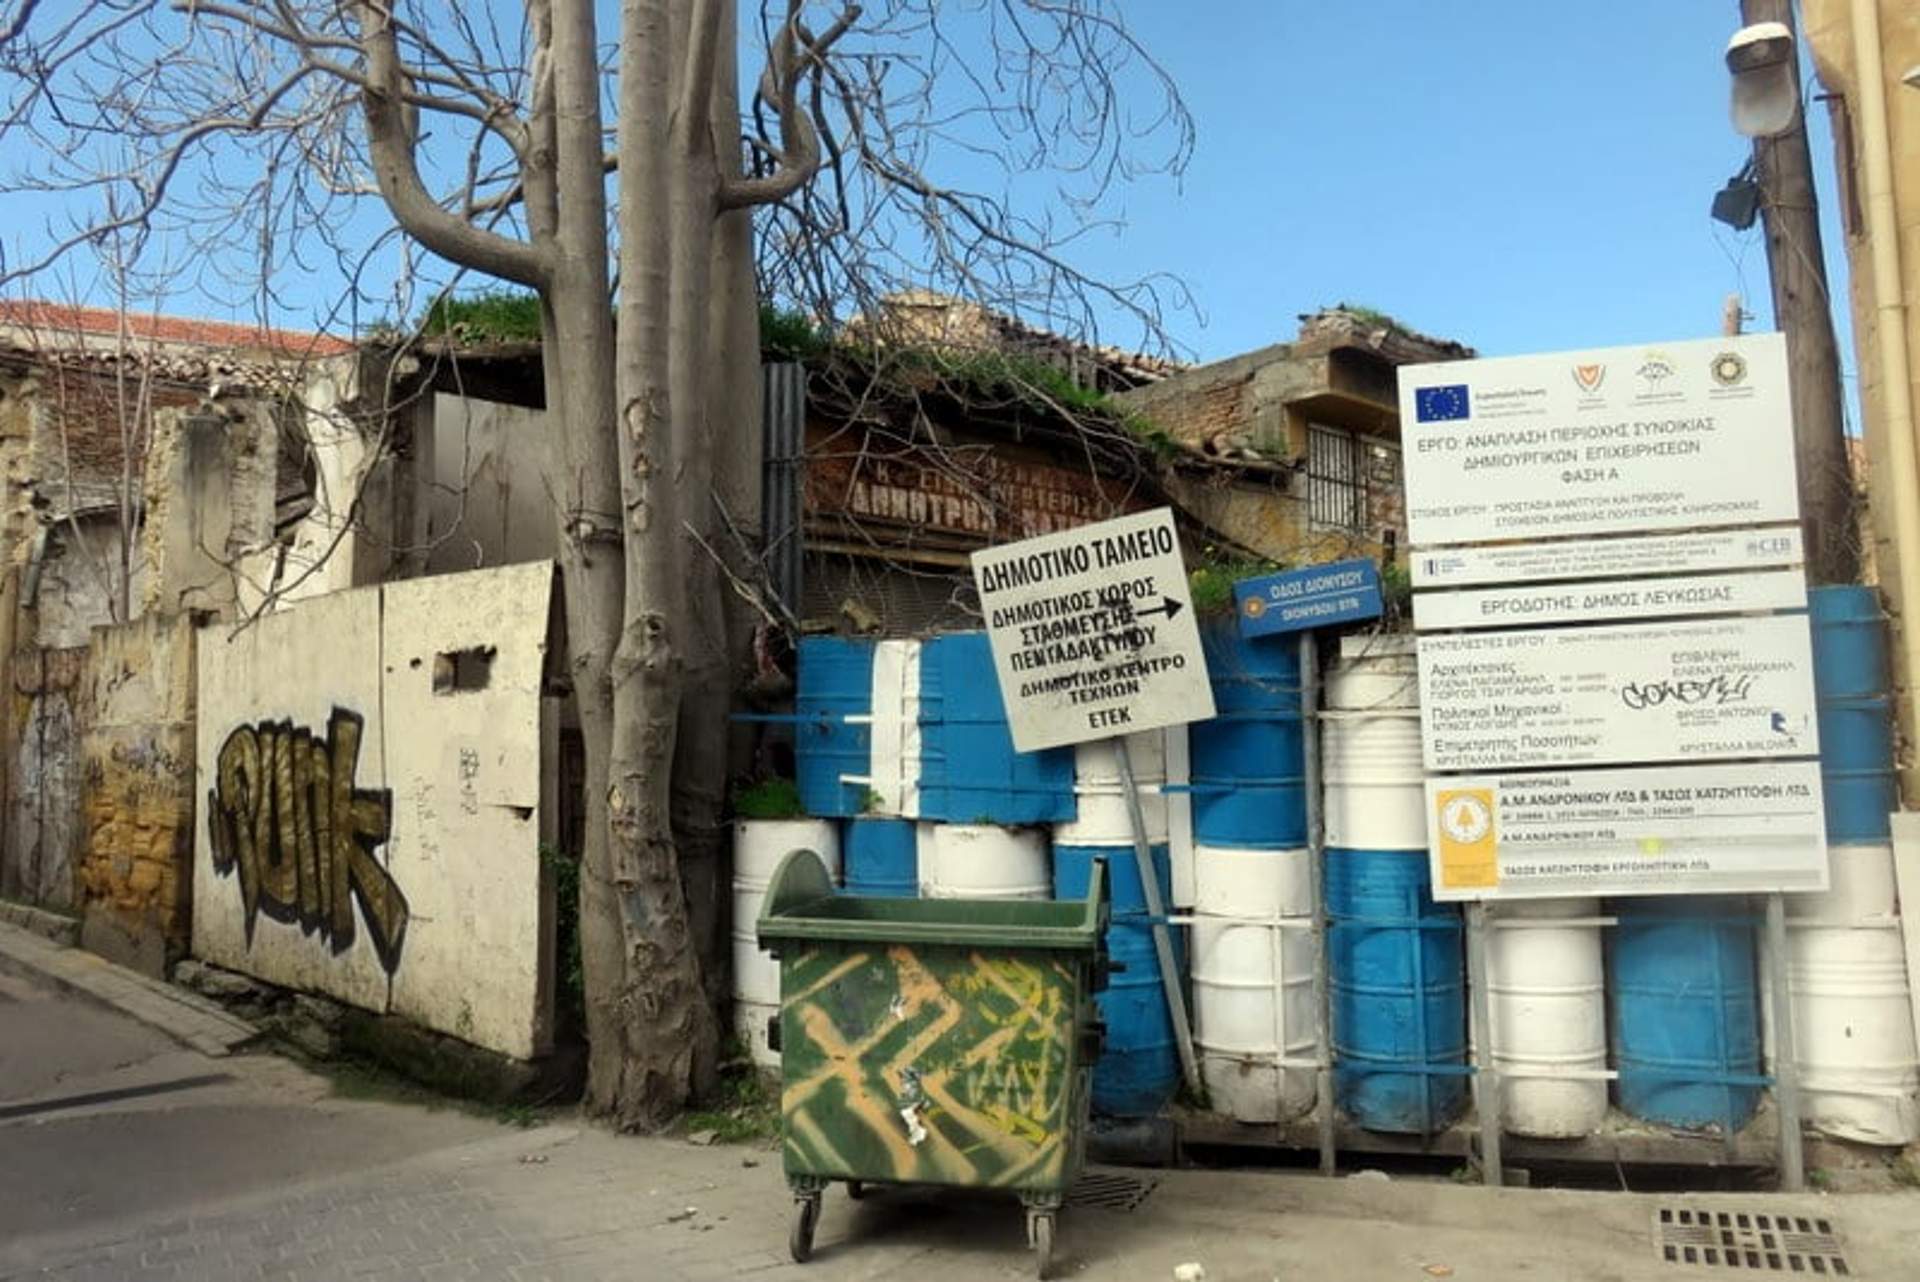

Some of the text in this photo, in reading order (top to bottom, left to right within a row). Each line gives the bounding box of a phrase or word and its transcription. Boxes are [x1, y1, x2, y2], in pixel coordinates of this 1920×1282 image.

[1466, 430, 1548, 449] ΑΝΑΠΛΑΣΗ
[1551, 423, 1629, 443] ΠΕΡΙΟΧΗΣ
[1634, 417, 1716, 437] ΣΥΝΟΙΚΙΑΣ
[1464, 439, 1700, 471] ΔΗΜΙΟΥΡΓΙΚΩΝ ΕΠΙΧΕΙΡΗΣΕΩΝ
[1561, 466, 1619, 484] ΦΑΣΗ Α
[982, 525, 1173, 594] ΔΗΜΟΤΙΚΟ ΤΑΜΕΙΟ
[1270, 582, 1304, 599] ΟΔΟΣ
[1583, 592, 1639, 609] ΔΗΜΟΣ
[1643, 586, 1733, 605] ΛΕΥΚΩΣΙΑΣ
[992, 590, 1094, 629] ΔΗΜΟΤΙΚΟΣ
[1020, 604, 1137, 647] ΣΤΑΘΜΕΥΣΗΣ
[1020, 654, 1185, 698] ΔΗΜΟΤΙΚΟ ΚΕΝΤΡΟ
[1069, 680, 1141, 705] ΤΕΧΝΩΝ
[1088, 706, 1132, 729] ΕΤΕΚ
[1639, 790, 1649, 802] &
[1653, 788, 1692, 802] ΤΑΣΟΣ
